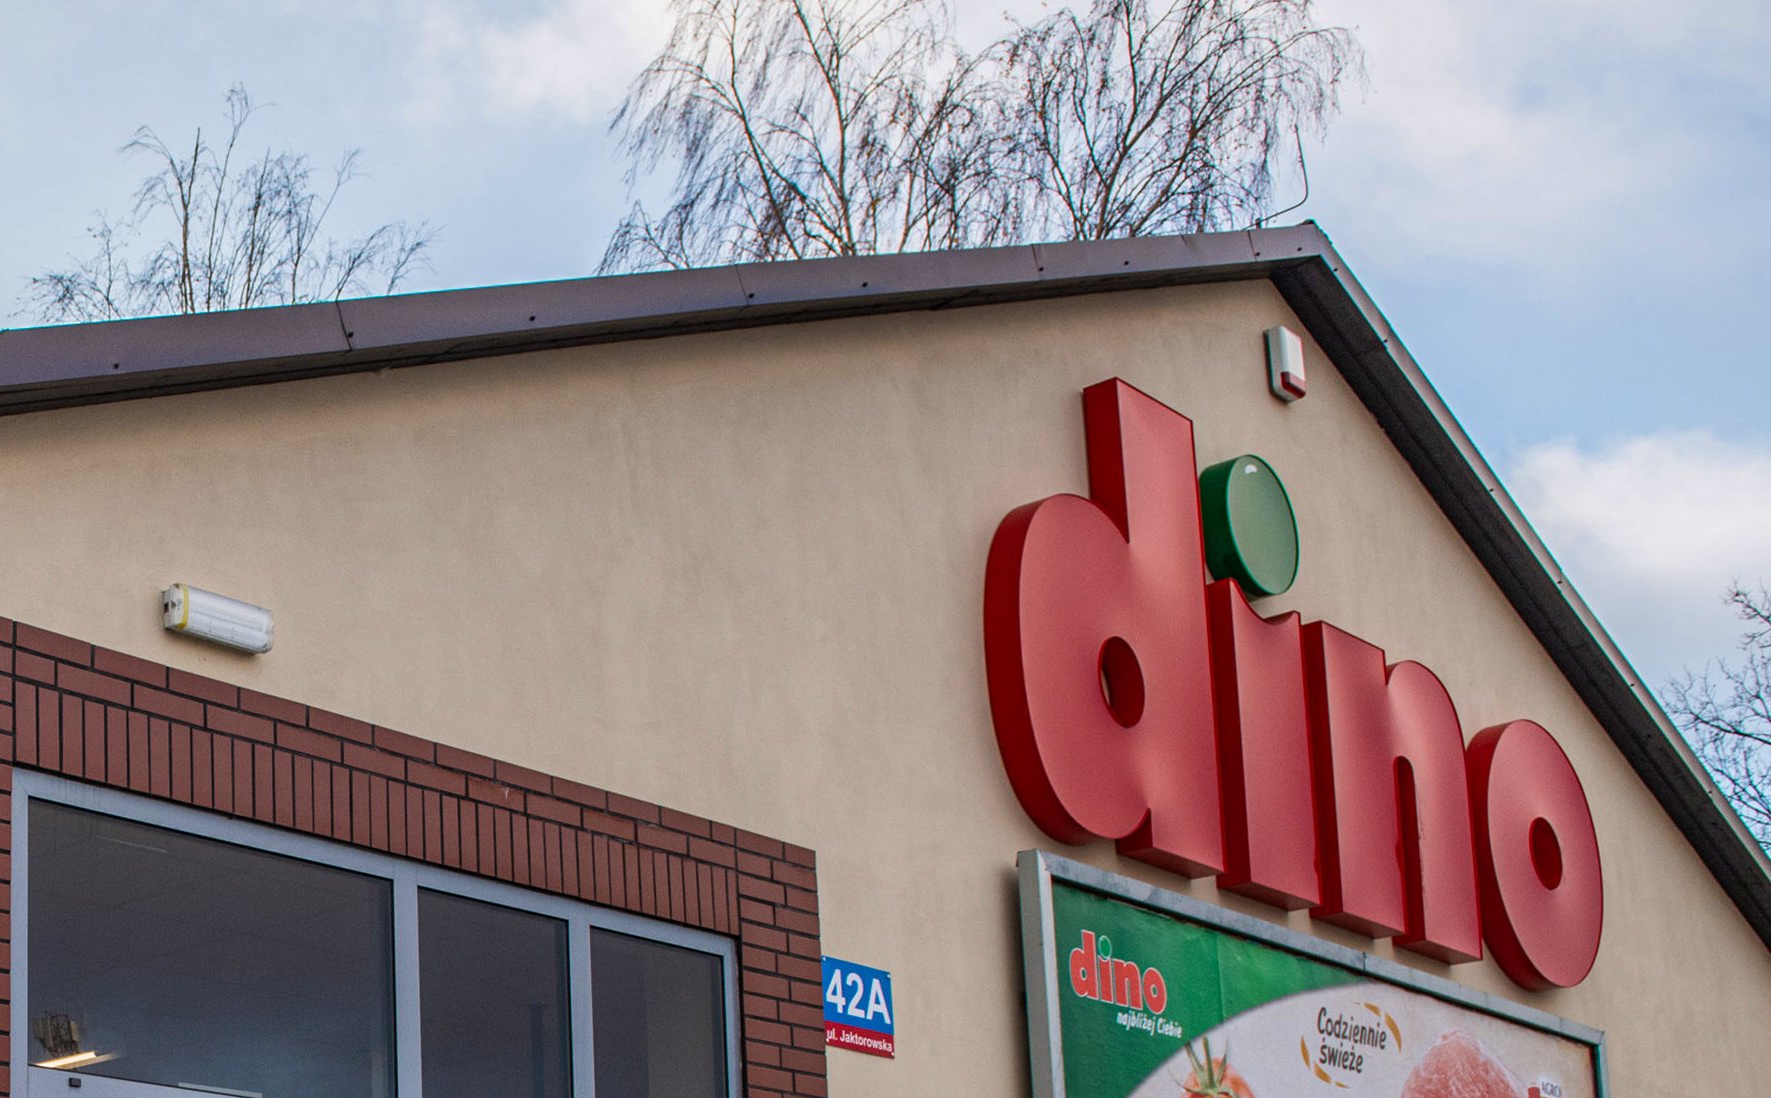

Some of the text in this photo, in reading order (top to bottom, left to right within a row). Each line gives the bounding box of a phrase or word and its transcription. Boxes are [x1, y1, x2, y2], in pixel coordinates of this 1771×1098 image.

[983, 376, 1604, 993] dino
[1069, 929, 1168, 1015] dino
[826, 968, 892, 1025] 42A
[839, 1029, 894, 1053] Jaktorowska
[1157, 1017, 1183, 1039] Ciebie
[1317, 1006, 1387, 1050] Codziennie
[1319, 1036, 1364, 1074] świeże
